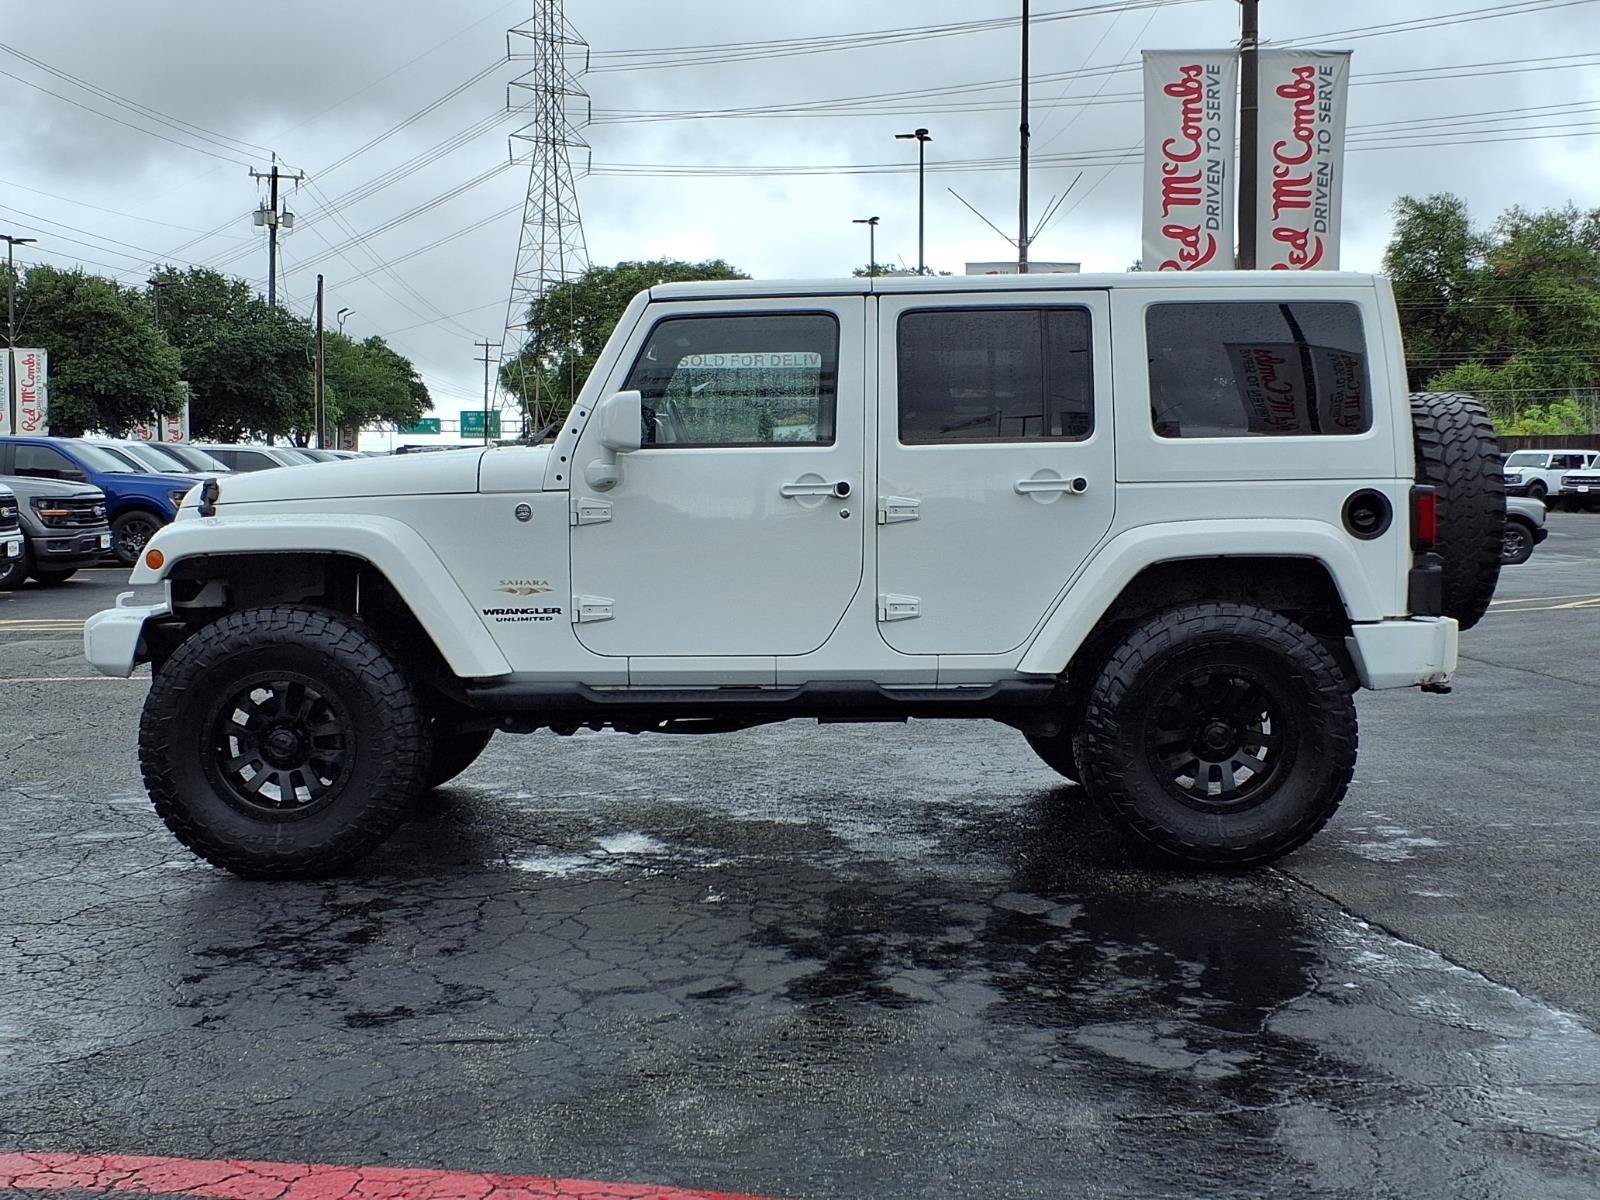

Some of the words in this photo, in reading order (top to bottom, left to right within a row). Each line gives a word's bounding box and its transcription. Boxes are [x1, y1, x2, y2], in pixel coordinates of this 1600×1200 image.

[1206, 64, 1221, 122] SERVE
[1319, 65, 1333, 123] SERVE
[1161, 64, 1203, 218] McCombs
[1206, 127, 1221, 152] TO
[1272, 65, 1315, 221] McCombs
[1317, 130, 1331, 155] TO
[1206, 160, 1221, 231] DRIVEN
[1314, 162, 1329, 233] DRIVEN
[1270, 227, 1324, 271] ed
[21, 353, 36, 406] McCombs
[679, 355, 725, 367] SOLD
[730, 355, 764, 367] FOR
[21, 408, 42, 432] Red
